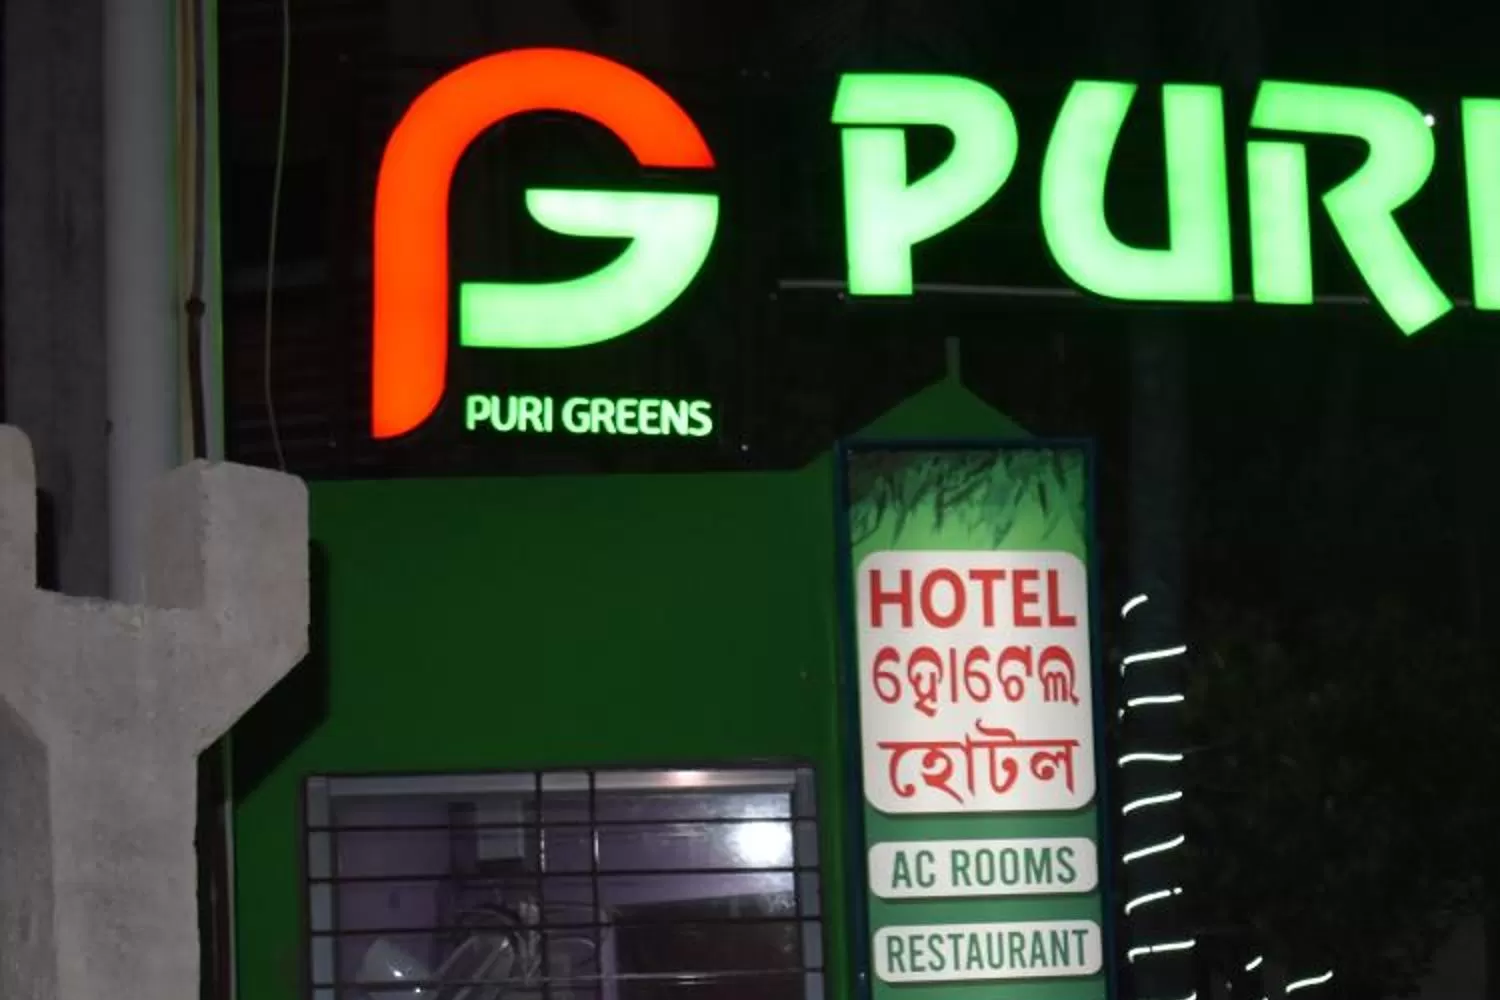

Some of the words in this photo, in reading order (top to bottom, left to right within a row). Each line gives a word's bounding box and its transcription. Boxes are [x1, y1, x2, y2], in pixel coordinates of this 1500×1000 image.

[466, 395, 553, 432] PURI
[561, 397, 713, 436] GREENS
[869, 568, 1077, 628] HOTEL
[873, 645, 1079, 717] ହୋଟେଲ
[891, 850, 935, 888] AC
[951, 846, 1077, 886] ROOMS
[886, 929, 1089, 973] RESTAURANT
